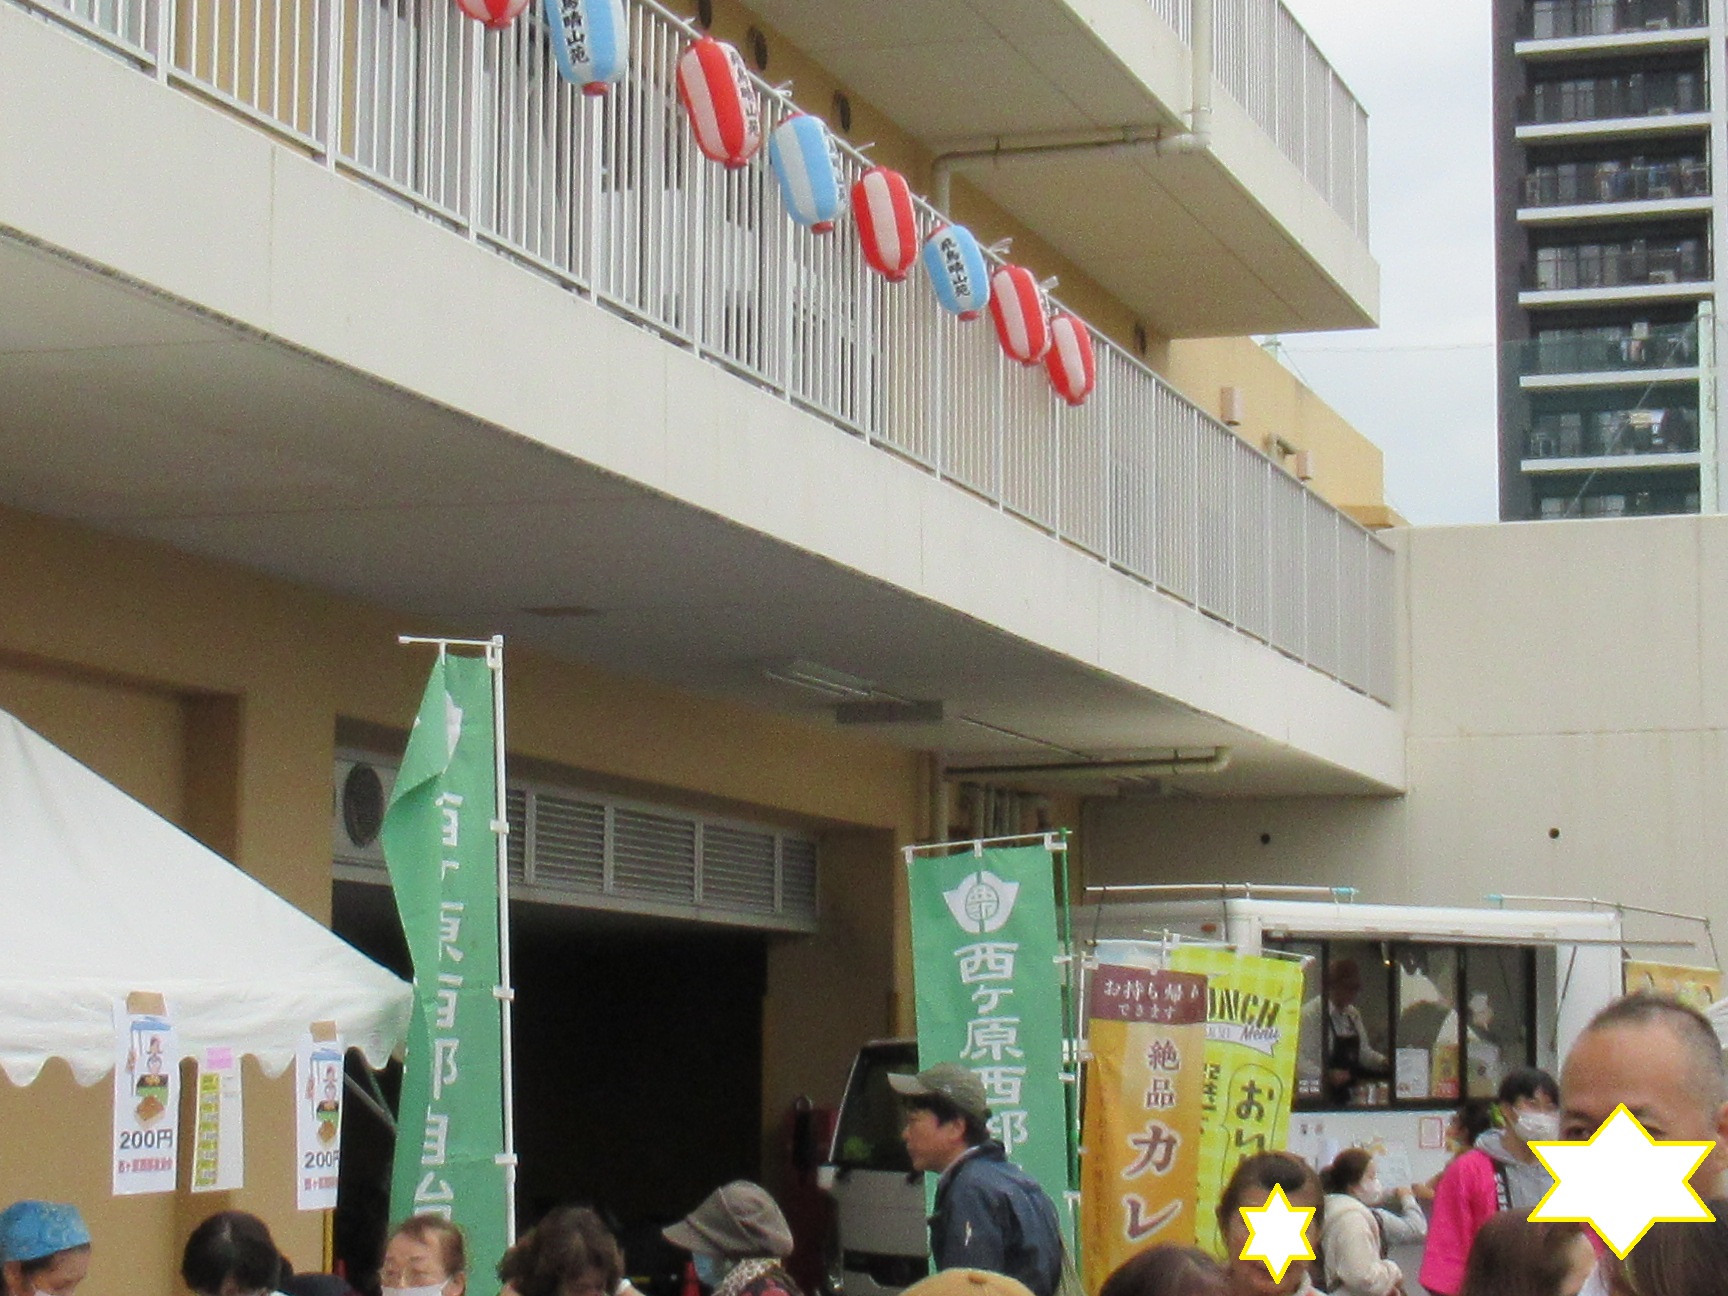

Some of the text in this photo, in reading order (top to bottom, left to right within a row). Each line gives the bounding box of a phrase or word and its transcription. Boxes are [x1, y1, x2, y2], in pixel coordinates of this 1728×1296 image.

[939, 237, 972, 298] 飛鳥晴山苑
[1103, 979, 1200, 1004] お持ち帰り
[1118, 1003, 1176, 1020] できます
[1240, 1025, 1282, 1042] Menu
[119, 1128, 174, 1150] 200円
